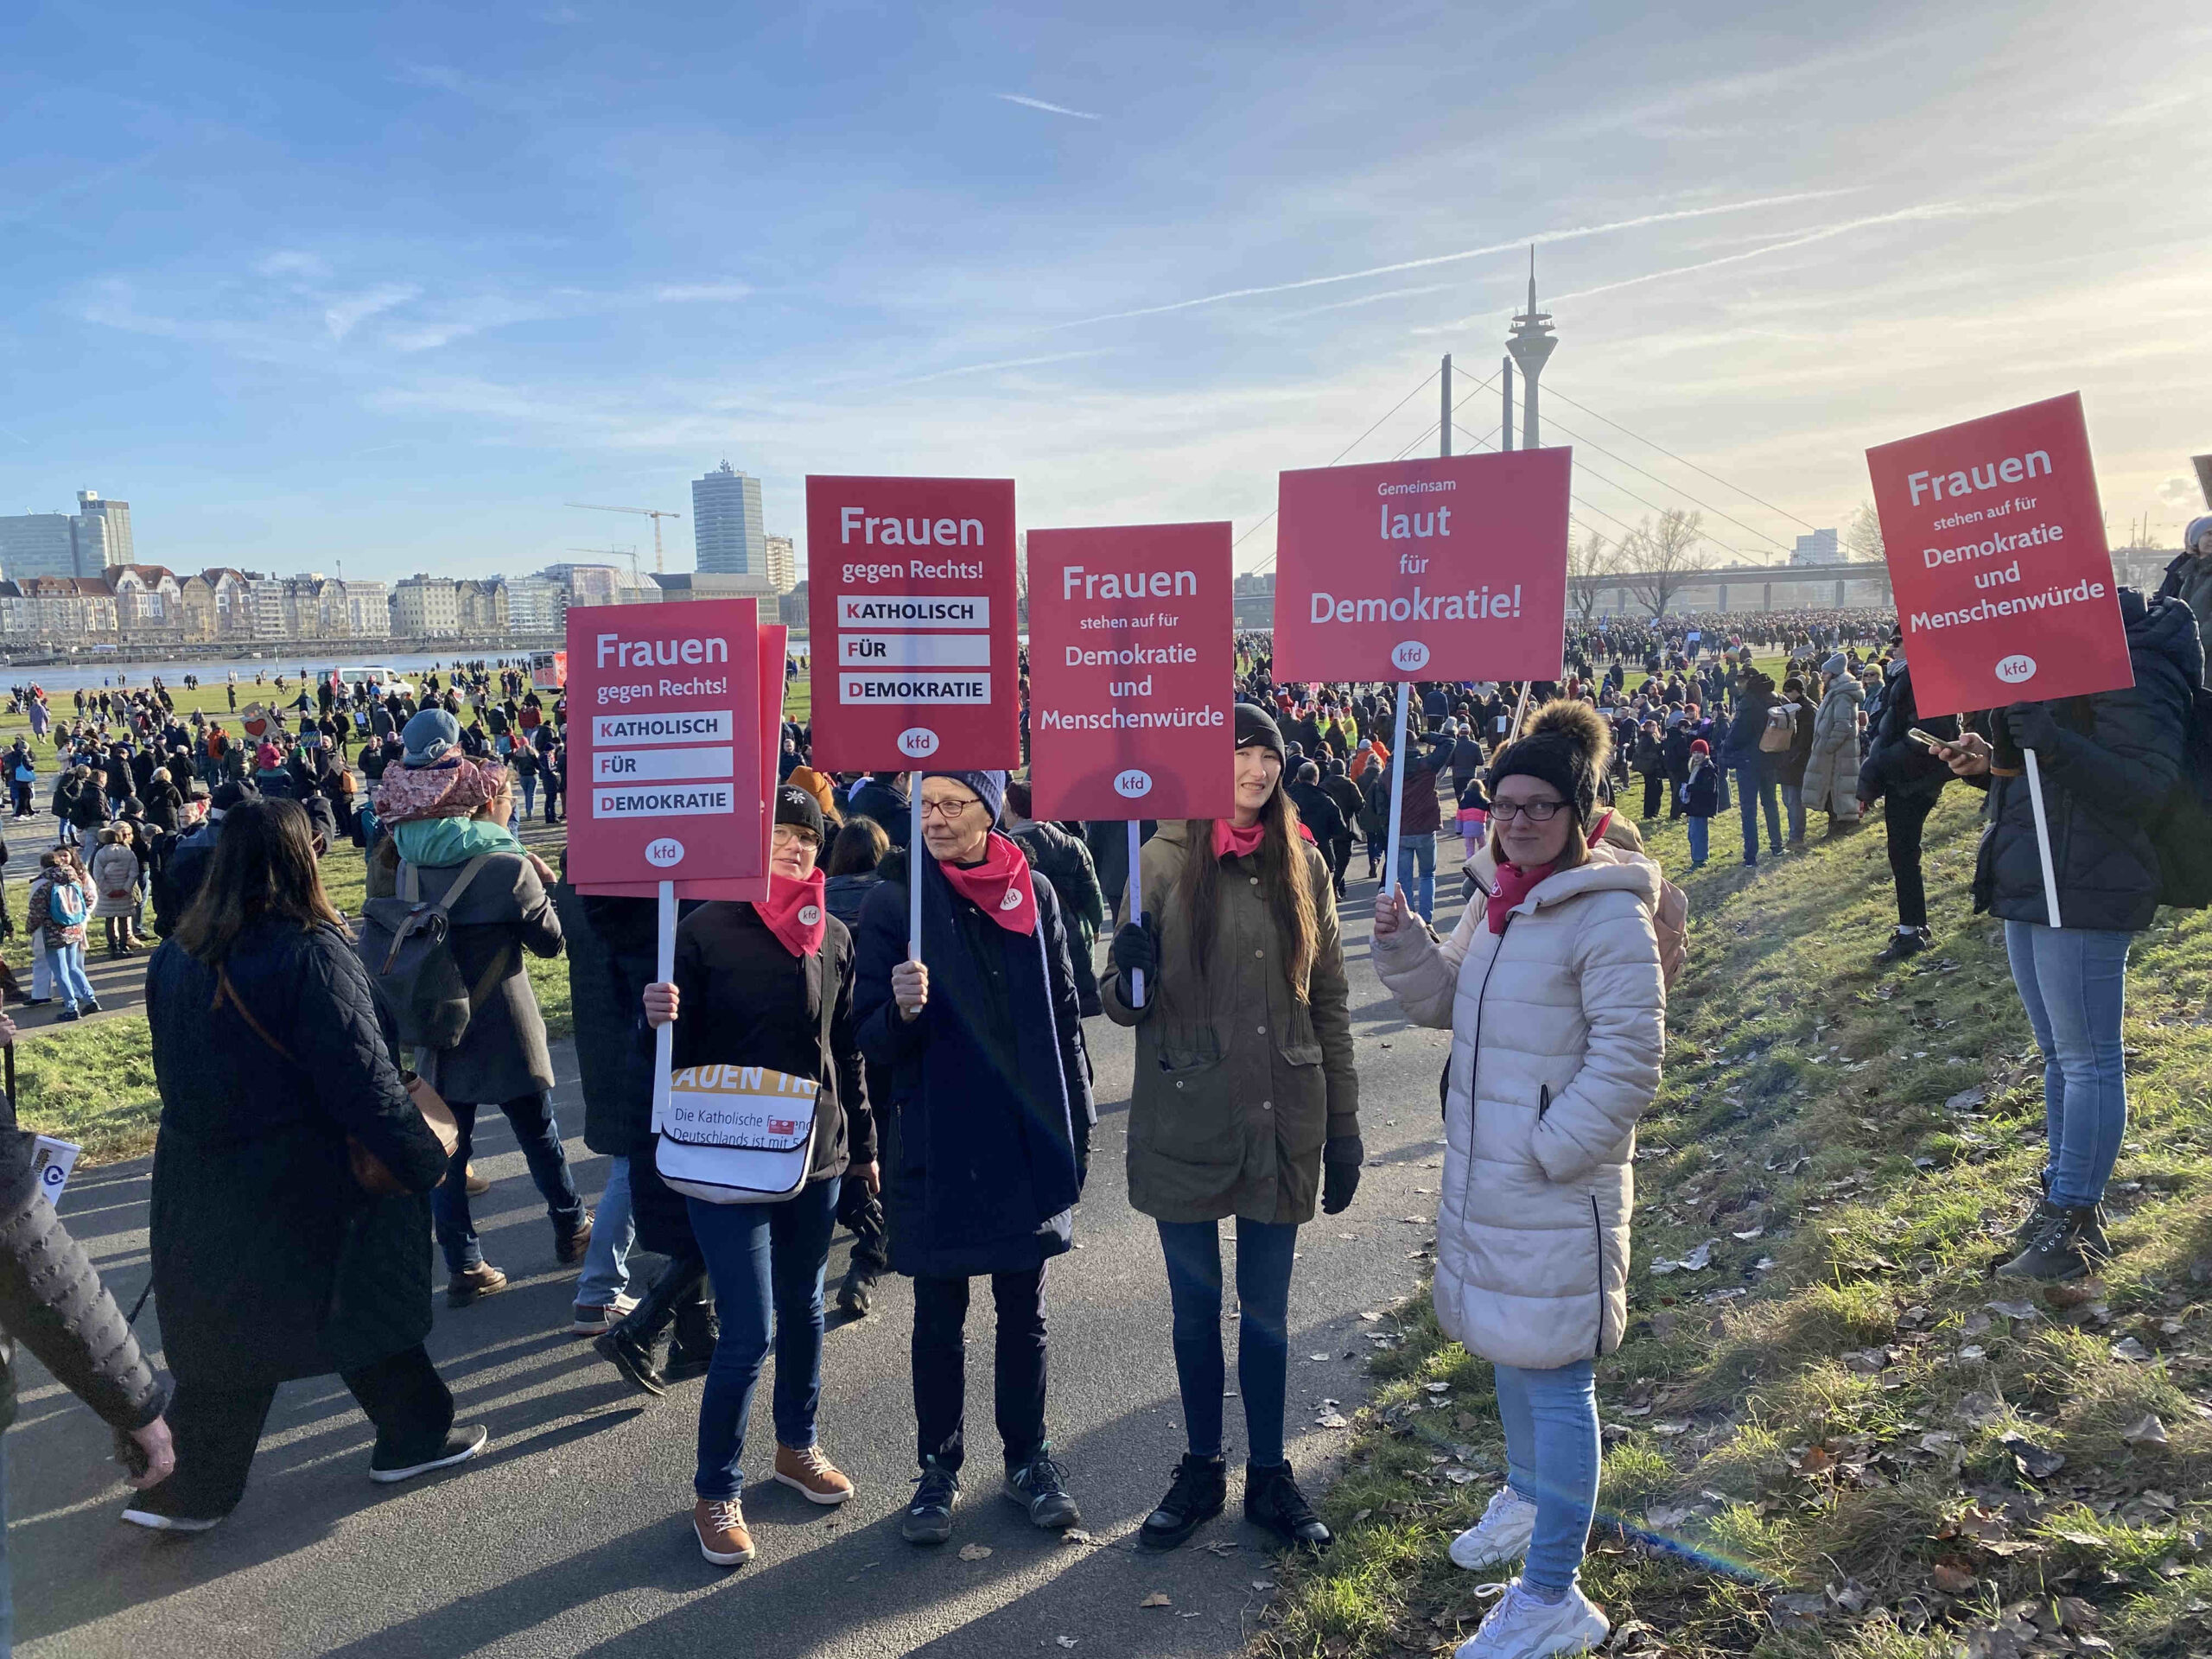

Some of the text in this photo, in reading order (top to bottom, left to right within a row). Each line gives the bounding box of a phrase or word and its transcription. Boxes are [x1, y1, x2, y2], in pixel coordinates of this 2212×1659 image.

[1907, 448, 2053, 506] Frauen
[1377, 480, 1457, 496] Gemeinsam
[1381, 504, 1452, 540] laut
[1934, 495, 2037, 531] stehen auf für
[841, 506, 984, 546] Frauen
[1923, 523, 2064, 569] Demokratie
[842, 560, 983, 583] gegen Rechts!
[1400, 553, 1429, 574] für
[1063, 566, 1197, 600] Frauen
[1974, 561, 2021, 589] und
[847, 603, 974, 620] KATHOLISCH
[1311, 584, 1522, 624] Demokratie!
[1910, 579, 2106, 633] Menschenwürde
[1080, 612, 1179, 630] stehen auf für
[596, 633, 728, 669] Frauen
[848, 639, 887, 658] FÜR
[1065, 643, 1197, 666] Demokratie
[1400, 648, 1421, 662] kfd
[2004, 662, 2028, 677] kfd
[597, 677, 728, 705] gegen Rechts!
[849, 682, 983, 697] DEMOKRATIE
[1109, 675, 1152, 697] und
[1040, 705, 1224, 729] Menschenwürde
[601, 719, 718, 737] KATHOLISCH
[906, 735, 930, 748] kfd
[601, 756, 637, 773] FÜR
[1122, 776, 1144, 790] kfd
[601, 792, 727, 812] DEMOKRATIE
[653, 845, 676, 859] kfd
[1003, 892, 1018, 906] kfd
[803, 910, 817, 920] kfd
[671, 1064, 763, 1090] AUEN
[675, 1108, 694, 1122] Die
[698, 1109, 763, 1127] Katholische
[673, 1128, 748, 1147] Deutschlands
[753, 1133, 765, 1147] ist
[768, 1135, 787, 1149] mit
